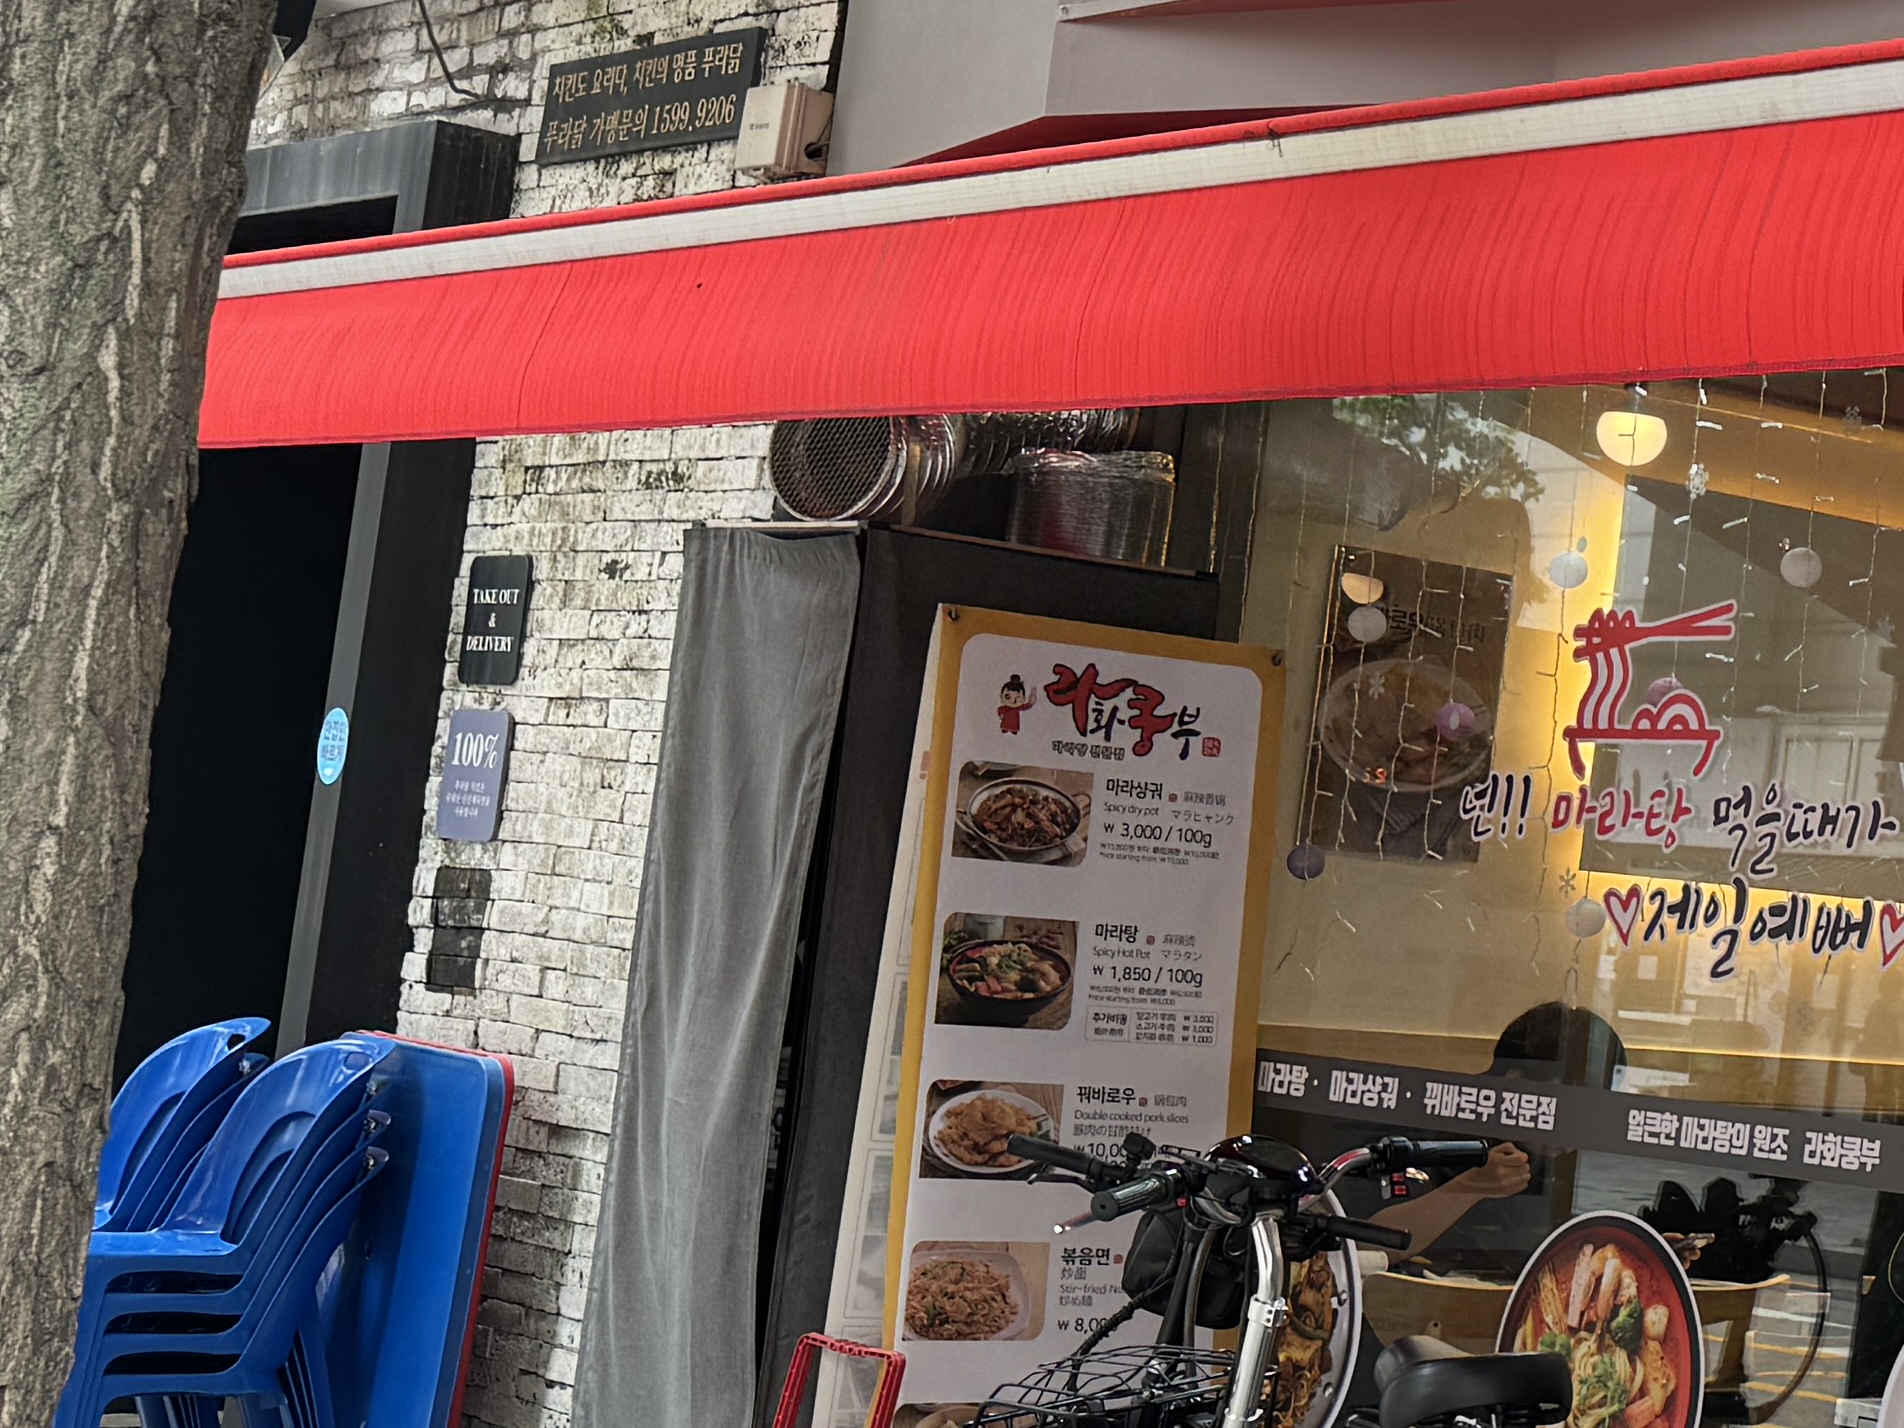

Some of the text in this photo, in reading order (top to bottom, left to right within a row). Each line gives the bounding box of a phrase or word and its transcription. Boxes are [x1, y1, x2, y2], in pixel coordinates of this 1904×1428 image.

[553, 72, 588, 103] 치킨도
[633, 56, 668, 90] 치킨의
[672, 49, 697, 83] 명품
[702, 42, 743, 77] 푸라닭
[544, 118, 587, 152] 푸라닭
[472, 588, 520, 605] TAKE OUT
[465, 636, 514, 652] DELIVERY
[1044, 663, 1201, 761] 라화쿵부
[451, 731, 499, 769] 100%
[1106, 778, 1163, 800] 마라샹궈
[1120, 822, 1162, 841] 3,000
[1177, 827, 1212, 848] 100g
[1551, 785, 1692, 849] 마라탕
[1714, 783, 1897, 876] 먹을때가
[1095, 923, 1139, 943] 마라탕
[1110, 966, 1152, 983] 1,850
[1167, 968, 1203, 987] 100g
[1077, 1086, 1136, 1105] 꿔바로우
[1257, 1061, 1557, 1131] 마라탕 마라샹궈 꿔바로우 전문점
[1627, 1109, 1679, 1146] 얼큰한
[1680, 1115, 1749, 1157] 마라탕의
[1752, 1122, 1790, 1162] 원조
[1802, 1131, 1882, 1173] 라화쿵부
[1061, 1247, 1111, 1266] 볶음면
